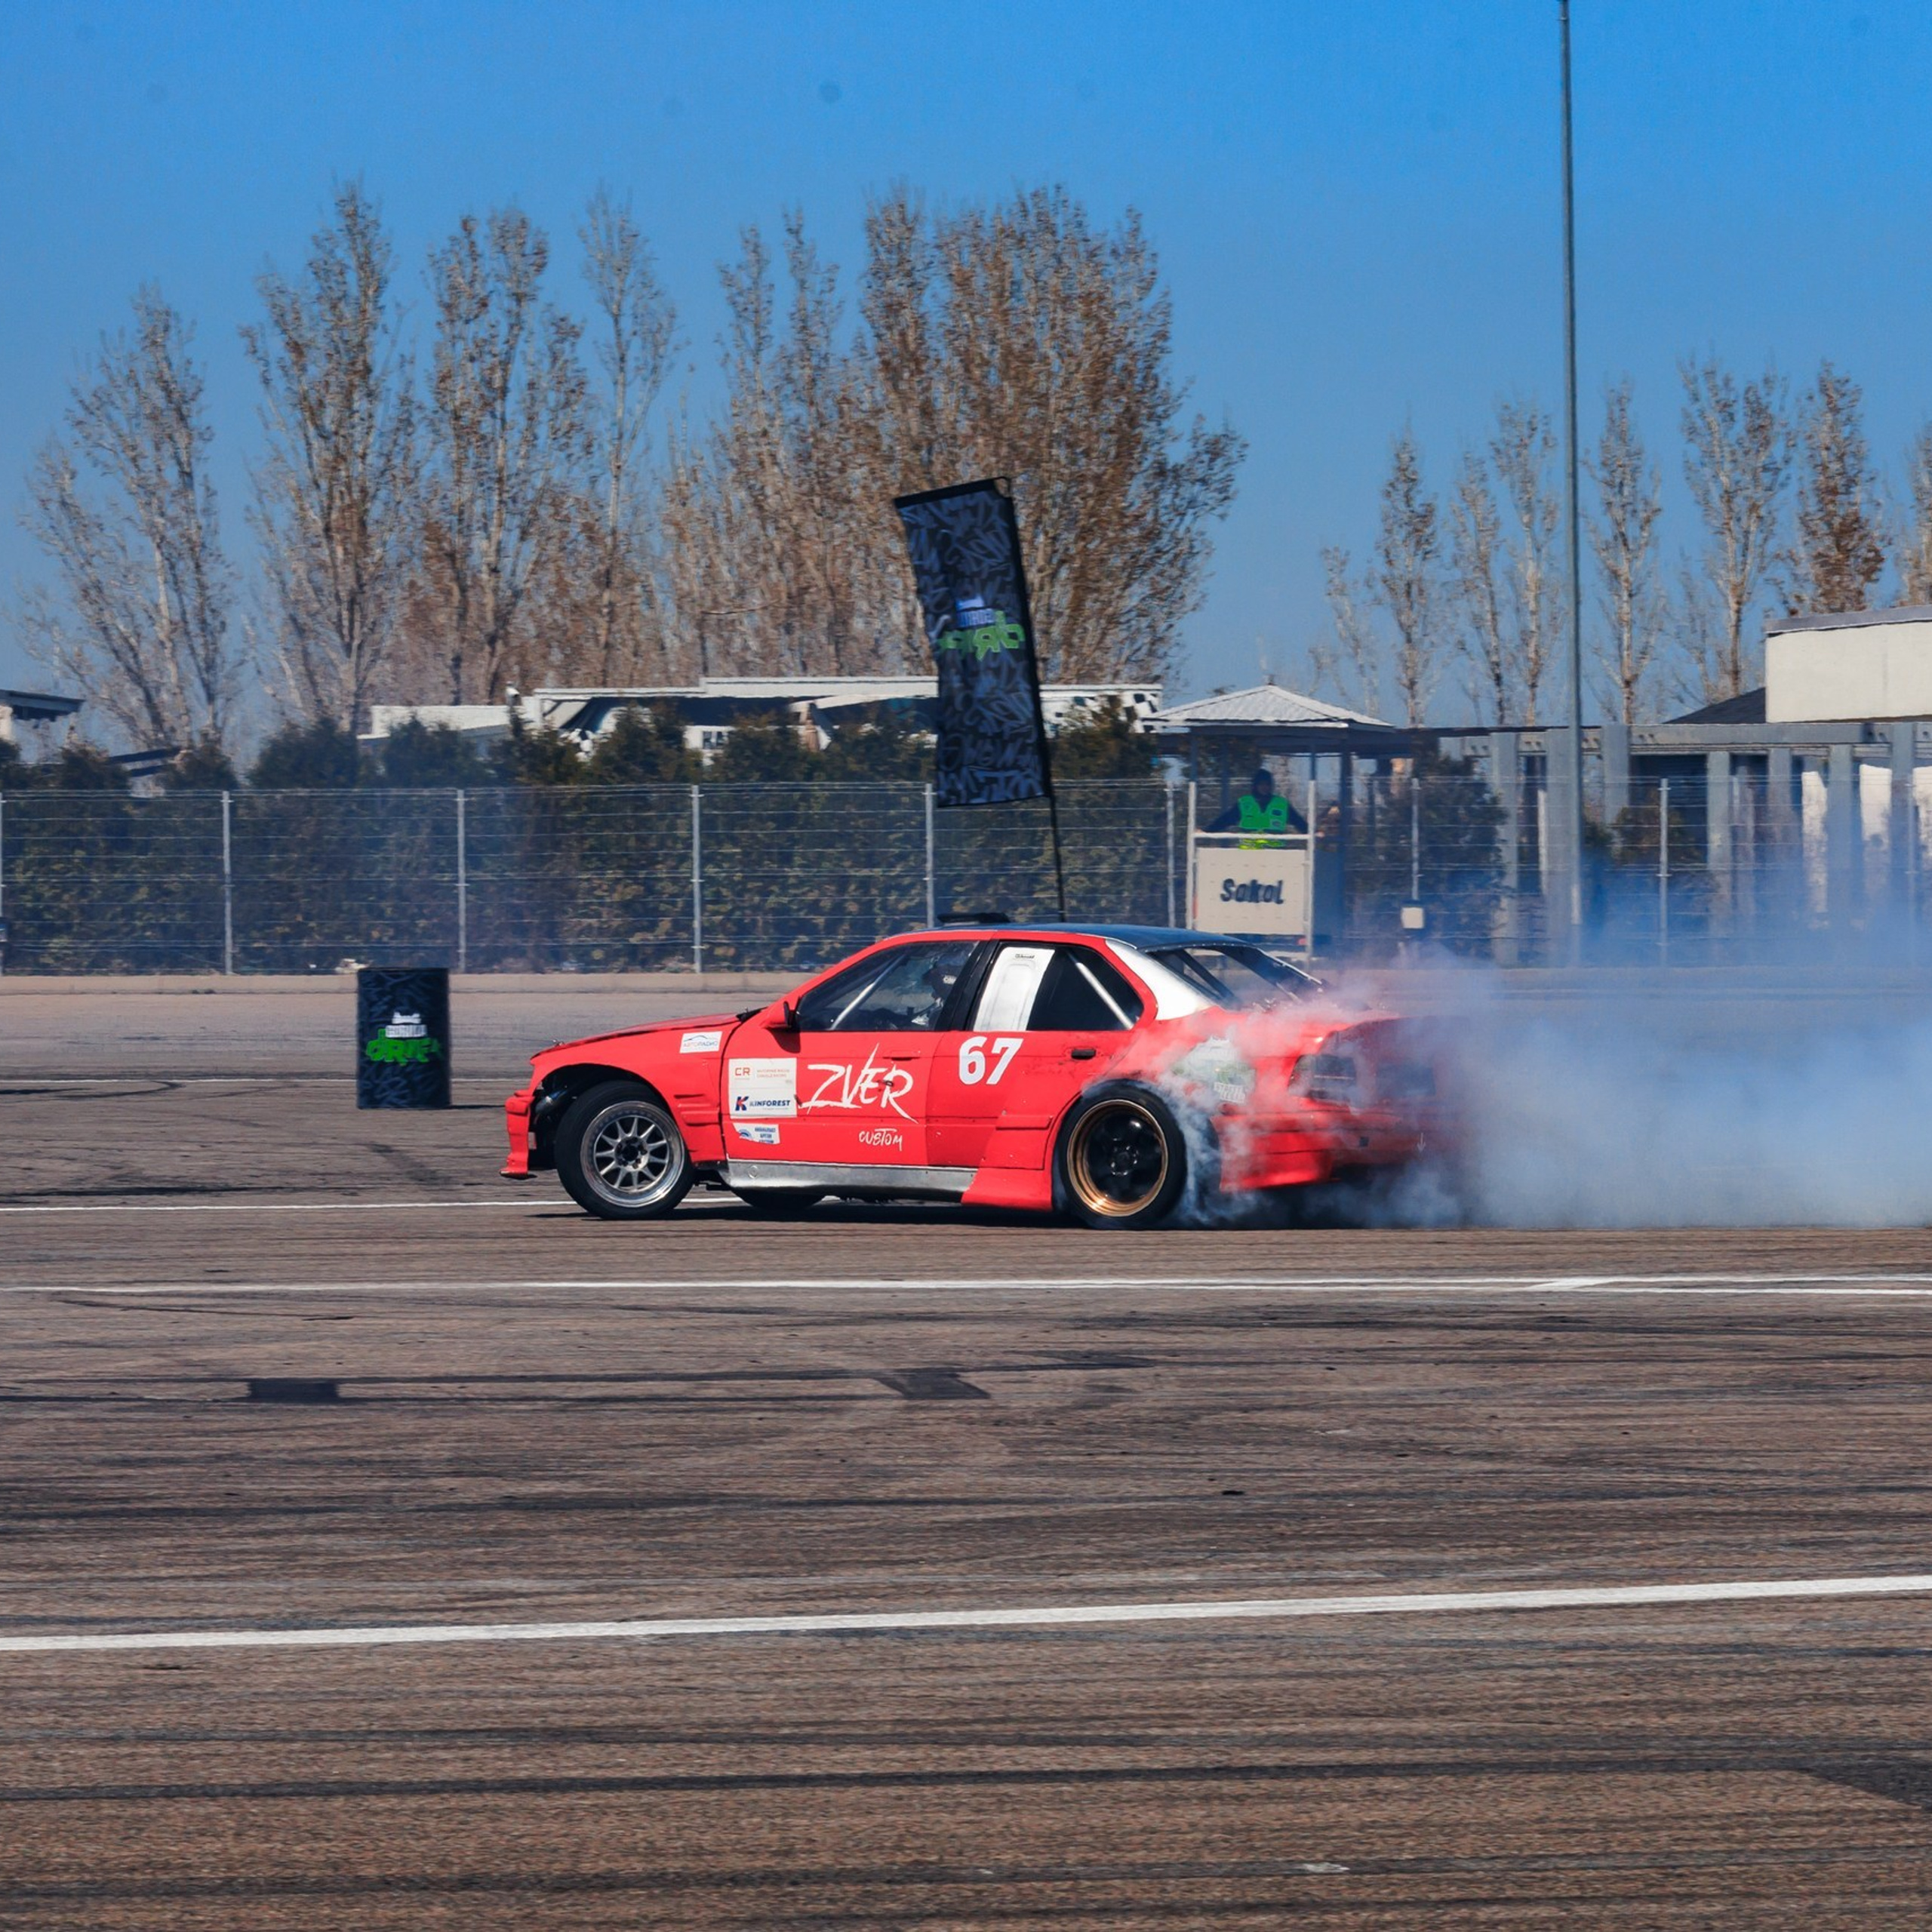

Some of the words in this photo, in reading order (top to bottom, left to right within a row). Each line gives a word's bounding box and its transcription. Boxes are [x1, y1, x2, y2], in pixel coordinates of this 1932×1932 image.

[735, 1067, 750, 1076] CR
[798, 1042, 919, 1124] ZVER
[959, 1036, 1024, 1084] 67
